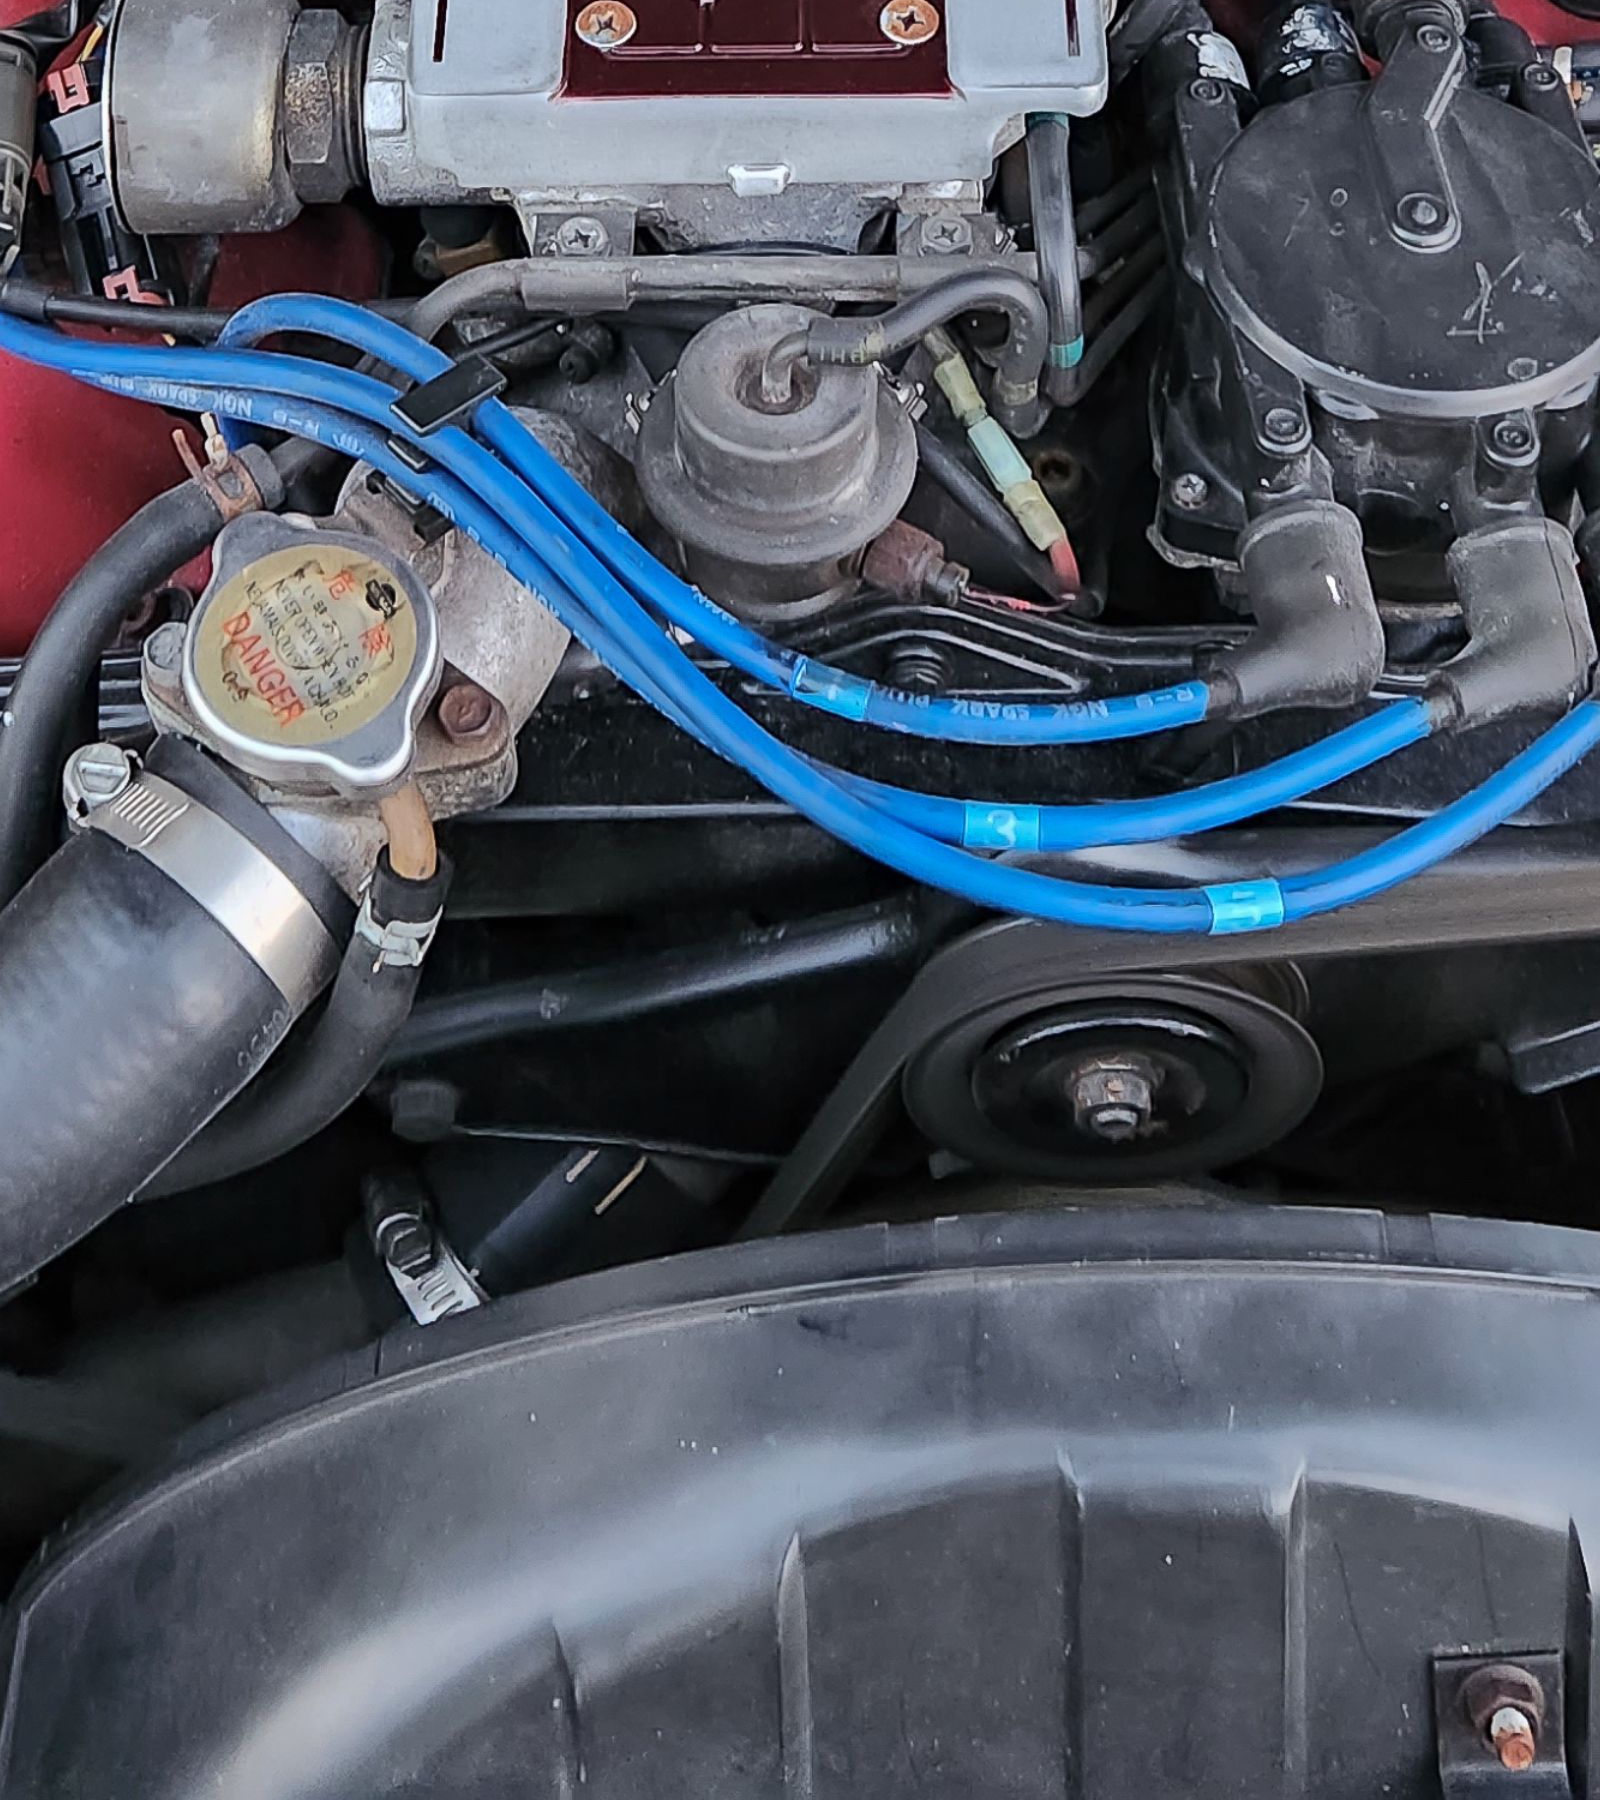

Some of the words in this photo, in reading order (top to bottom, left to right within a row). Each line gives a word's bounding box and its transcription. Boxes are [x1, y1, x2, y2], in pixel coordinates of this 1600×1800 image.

[211, 394, 253, 418] NGK
[223, 610, 306, 729] DANGER
[1051, 699, 1111, 721] NGK
